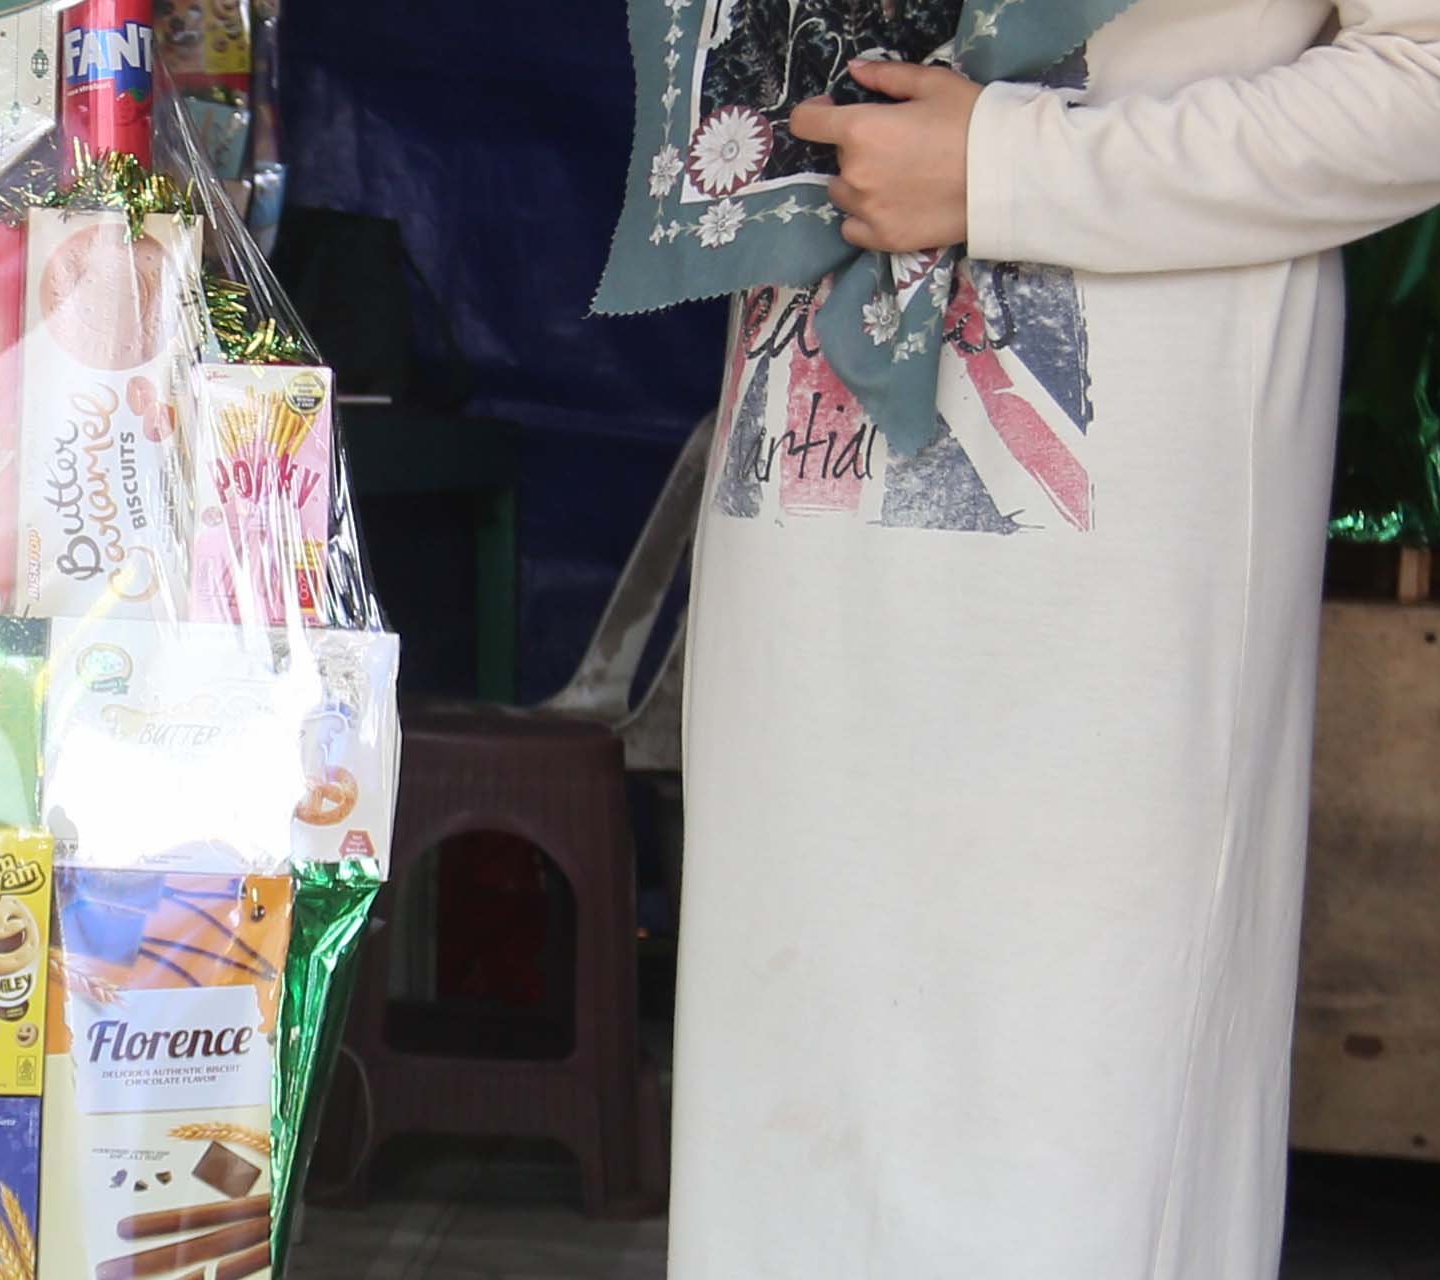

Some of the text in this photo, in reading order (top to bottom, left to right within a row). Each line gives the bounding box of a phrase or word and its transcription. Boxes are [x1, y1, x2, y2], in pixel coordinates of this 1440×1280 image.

[118, 431, 148, 530] BISCUITS
[85, 1019, 254, 1065] Florence
[101, 1066, 153, 1079] DELICIOUS
[154, 1066, 211, 1079] AUTHENTIC
[124, 1074, 177, 1087] CHOCOLATE
